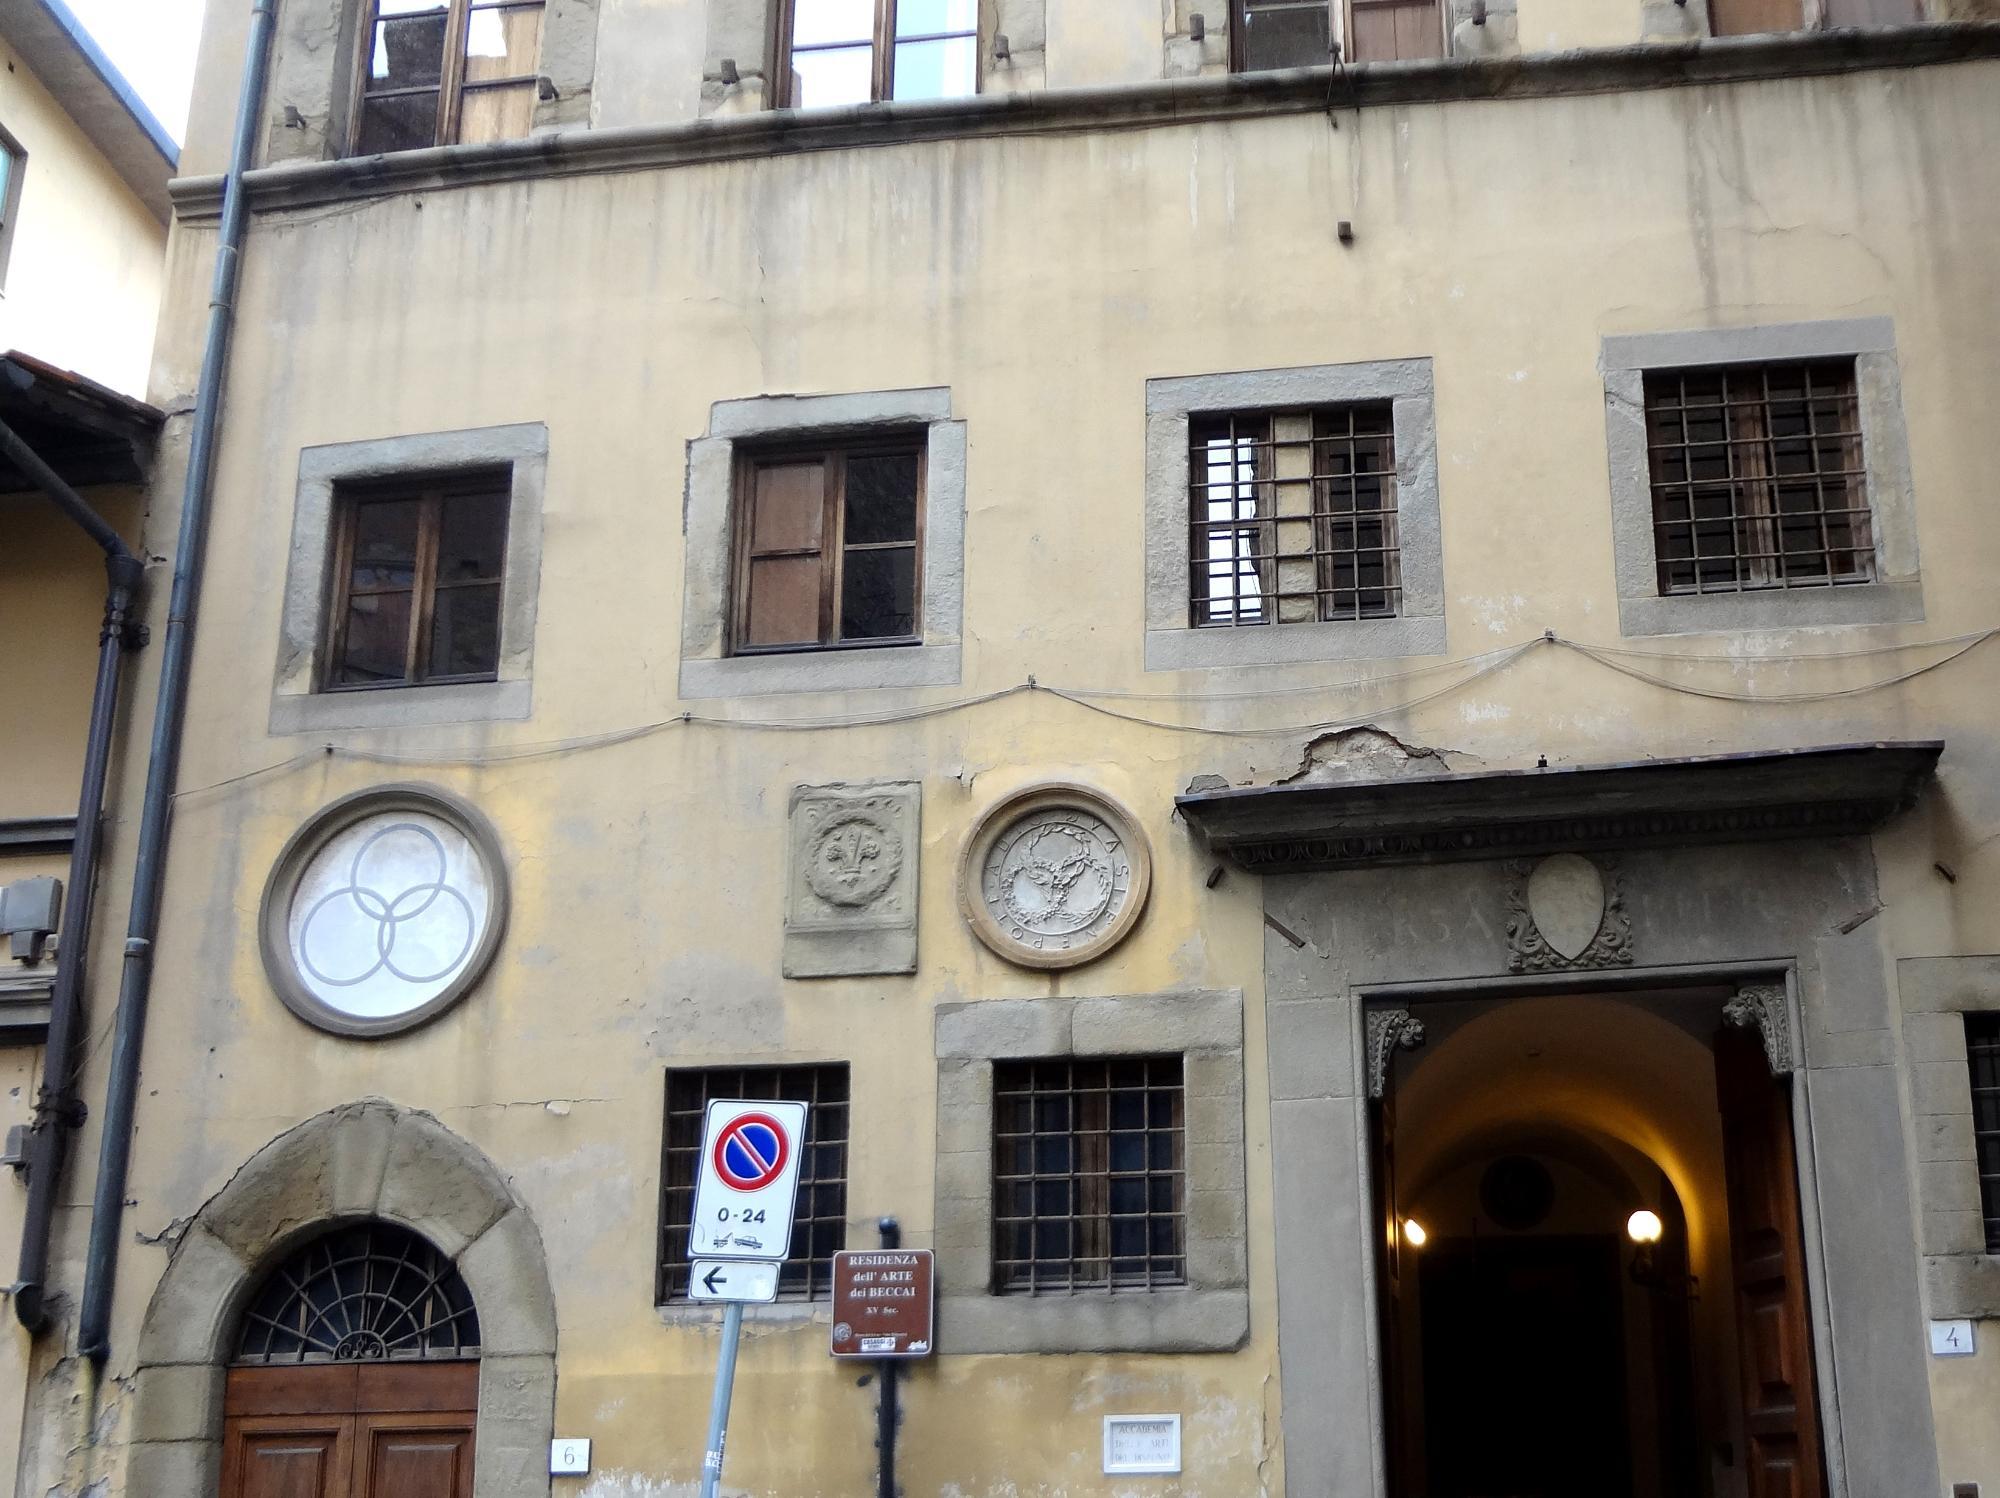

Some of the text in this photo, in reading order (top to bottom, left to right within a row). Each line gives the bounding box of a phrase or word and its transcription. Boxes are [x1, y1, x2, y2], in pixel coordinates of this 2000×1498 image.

[849, 1255, 918, 1265] RESIDENZA
[853, 1270, 913, 1281] dell' ARTE
[850, 1286, 916, 1297] dei BECCAI
[865, 1306, 879, 1314] XV
[1945, 1326, 1960, 1347] 4
[1119, 1423, 1167, 1434] ACCADEMIA
[564, 1446, 575, 1465] 6
